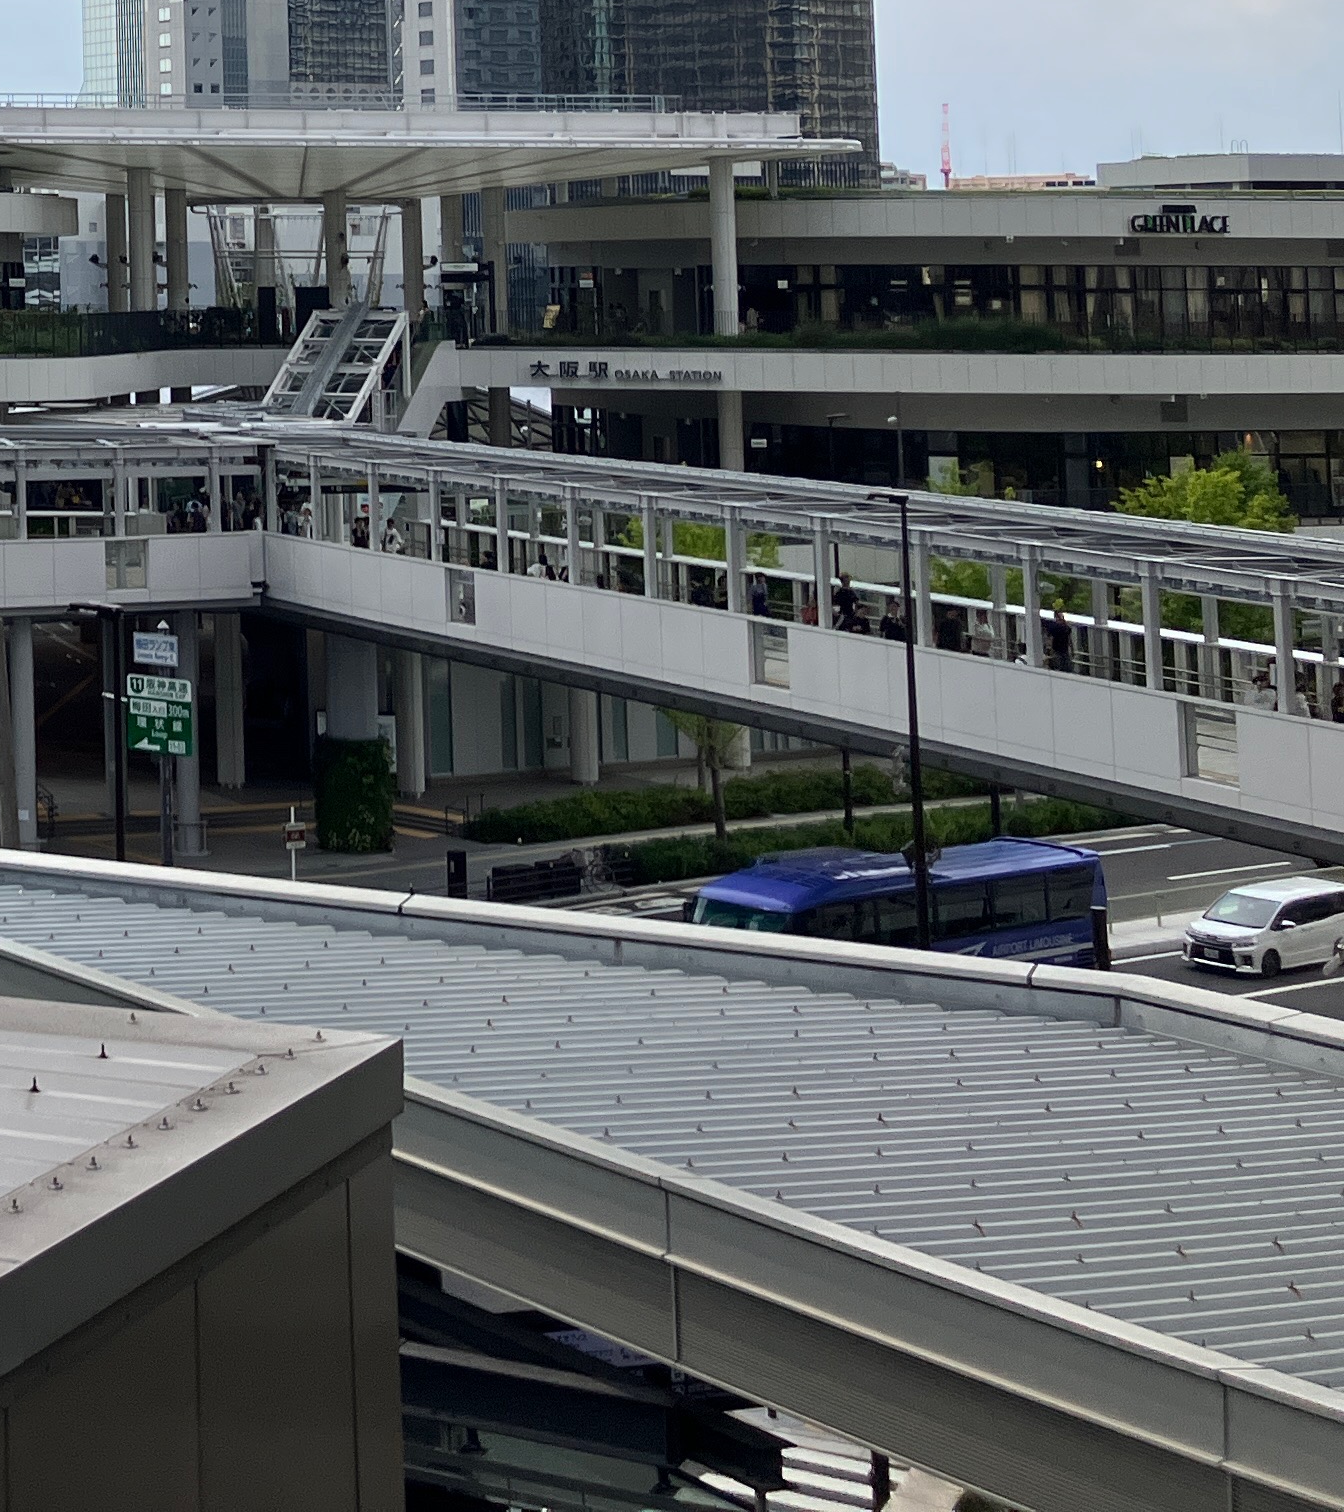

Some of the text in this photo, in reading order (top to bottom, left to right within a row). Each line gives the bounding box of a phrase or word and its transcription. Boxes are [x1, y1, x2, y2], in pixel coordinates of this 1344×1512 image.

[530, 360, 723, 381] 大阪駅 OSAKA STATION
[132, 678, 143, 691] 11
